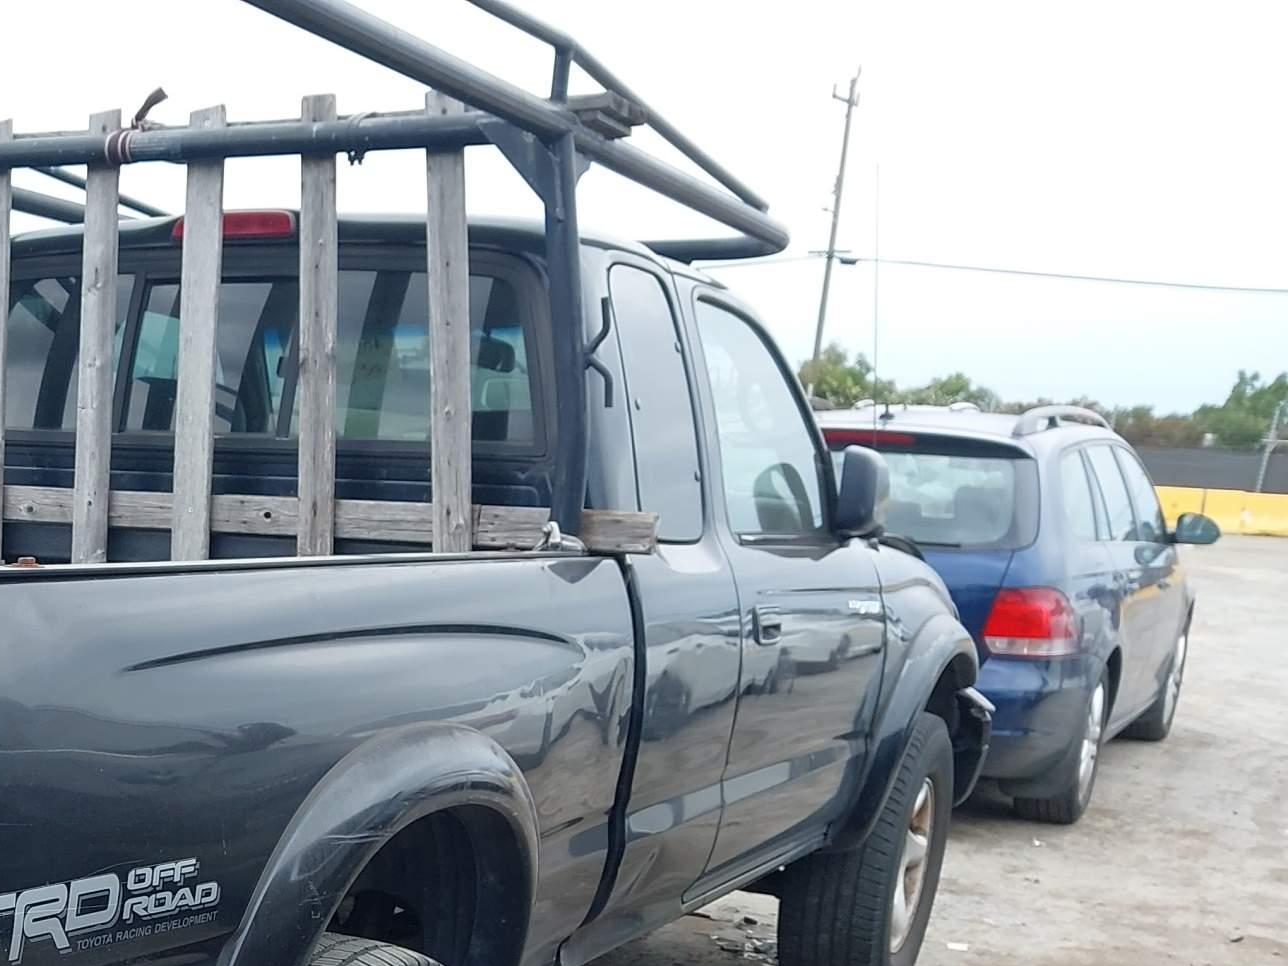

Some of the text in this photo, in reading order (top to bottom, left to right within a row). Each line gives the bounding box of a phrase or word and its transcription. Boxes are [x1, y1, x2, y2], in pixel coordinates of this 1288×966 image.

[127, 857, 199, 893] OFF
[122, 881, 221, 923] ROAD
[77, 910, 218, 951] TOYOTA RACING DEVELOPMENT
